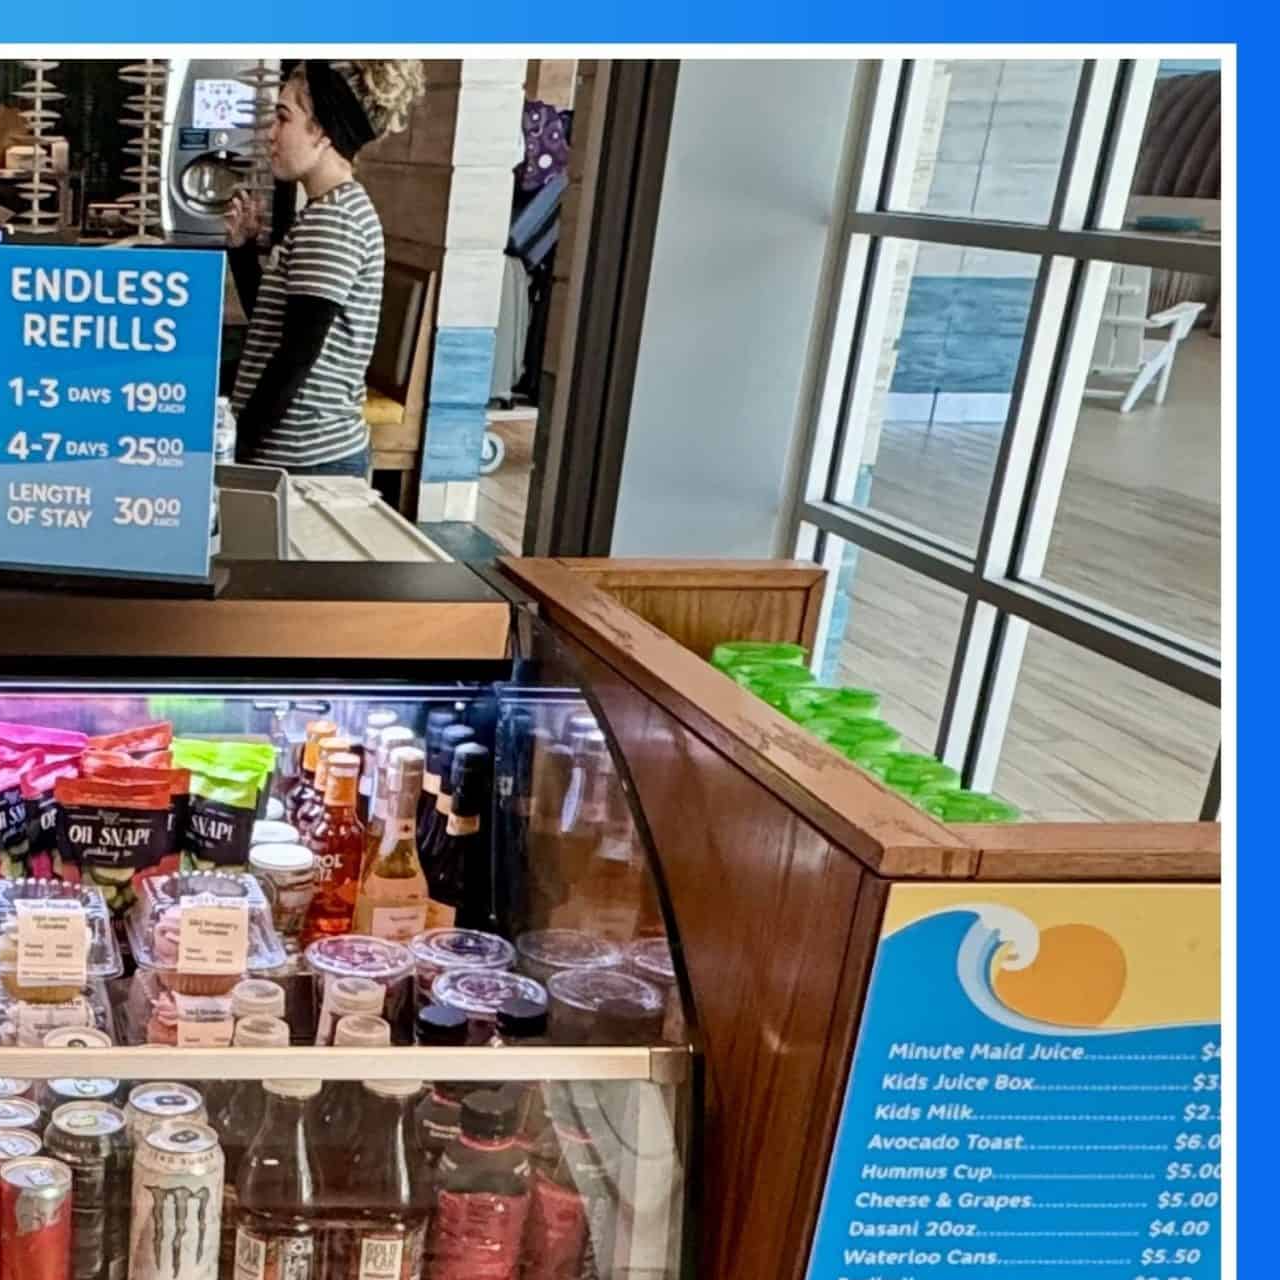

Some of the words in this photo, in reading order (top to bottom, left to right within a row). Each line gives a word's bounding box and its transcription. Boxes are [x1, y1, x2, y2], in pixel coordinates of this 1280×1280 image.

[11, 267, 188, 306] ENDLESS
[23, 313, 176, 352] REFILLS
[9, 378, 59, 407] 1-3
[67, 387, 112, 404] DAYS
[7, 431, 60, 461] 4-7
[65, 441, 110, 457] DAYS
[9, 482, 91, 505] LENGTH
[7, 506, 36, 525] OF
[40, 508, 93, 528] STAY
[889, 1043, 965, 1060] Minute
[970, 1043, 1025, 1060] Maid
[1030, 1044, 1084, 1060] Juice
[882, 1074, 928, 1090] Kids
[933, 1075, 989, 1090] Juice
[994, 1074, 1033, 1091] Box
[875, 1105, 921, 1120] Kids
[927, 1104, 973, 1120] Milk
[868, 1134, 959, 1150] Avocado
[967, 1134, 1024, 1150] Toast
[862, 1165, 947, 1179] Hummus
[953, 1164, 993, 1182] Cup
[855, 1192, 930, 1208] Cheese
[935, 1192, 951, 1208] &
[958, 1192, 1031, 1211] Grapes
[1158, 1191, 1218, 1209] $5.00
[849, 1221, 918, 1237] Dasani
[926, 1221, 976, 1237] 20oz
[1150, 1220, 1210, 1237] $4.00
[844, 1250, 941, 1265] Waterloo
[947, 1249, 997, 1264] Cans
[1141, 1248, 1201, 1265] $5.50
